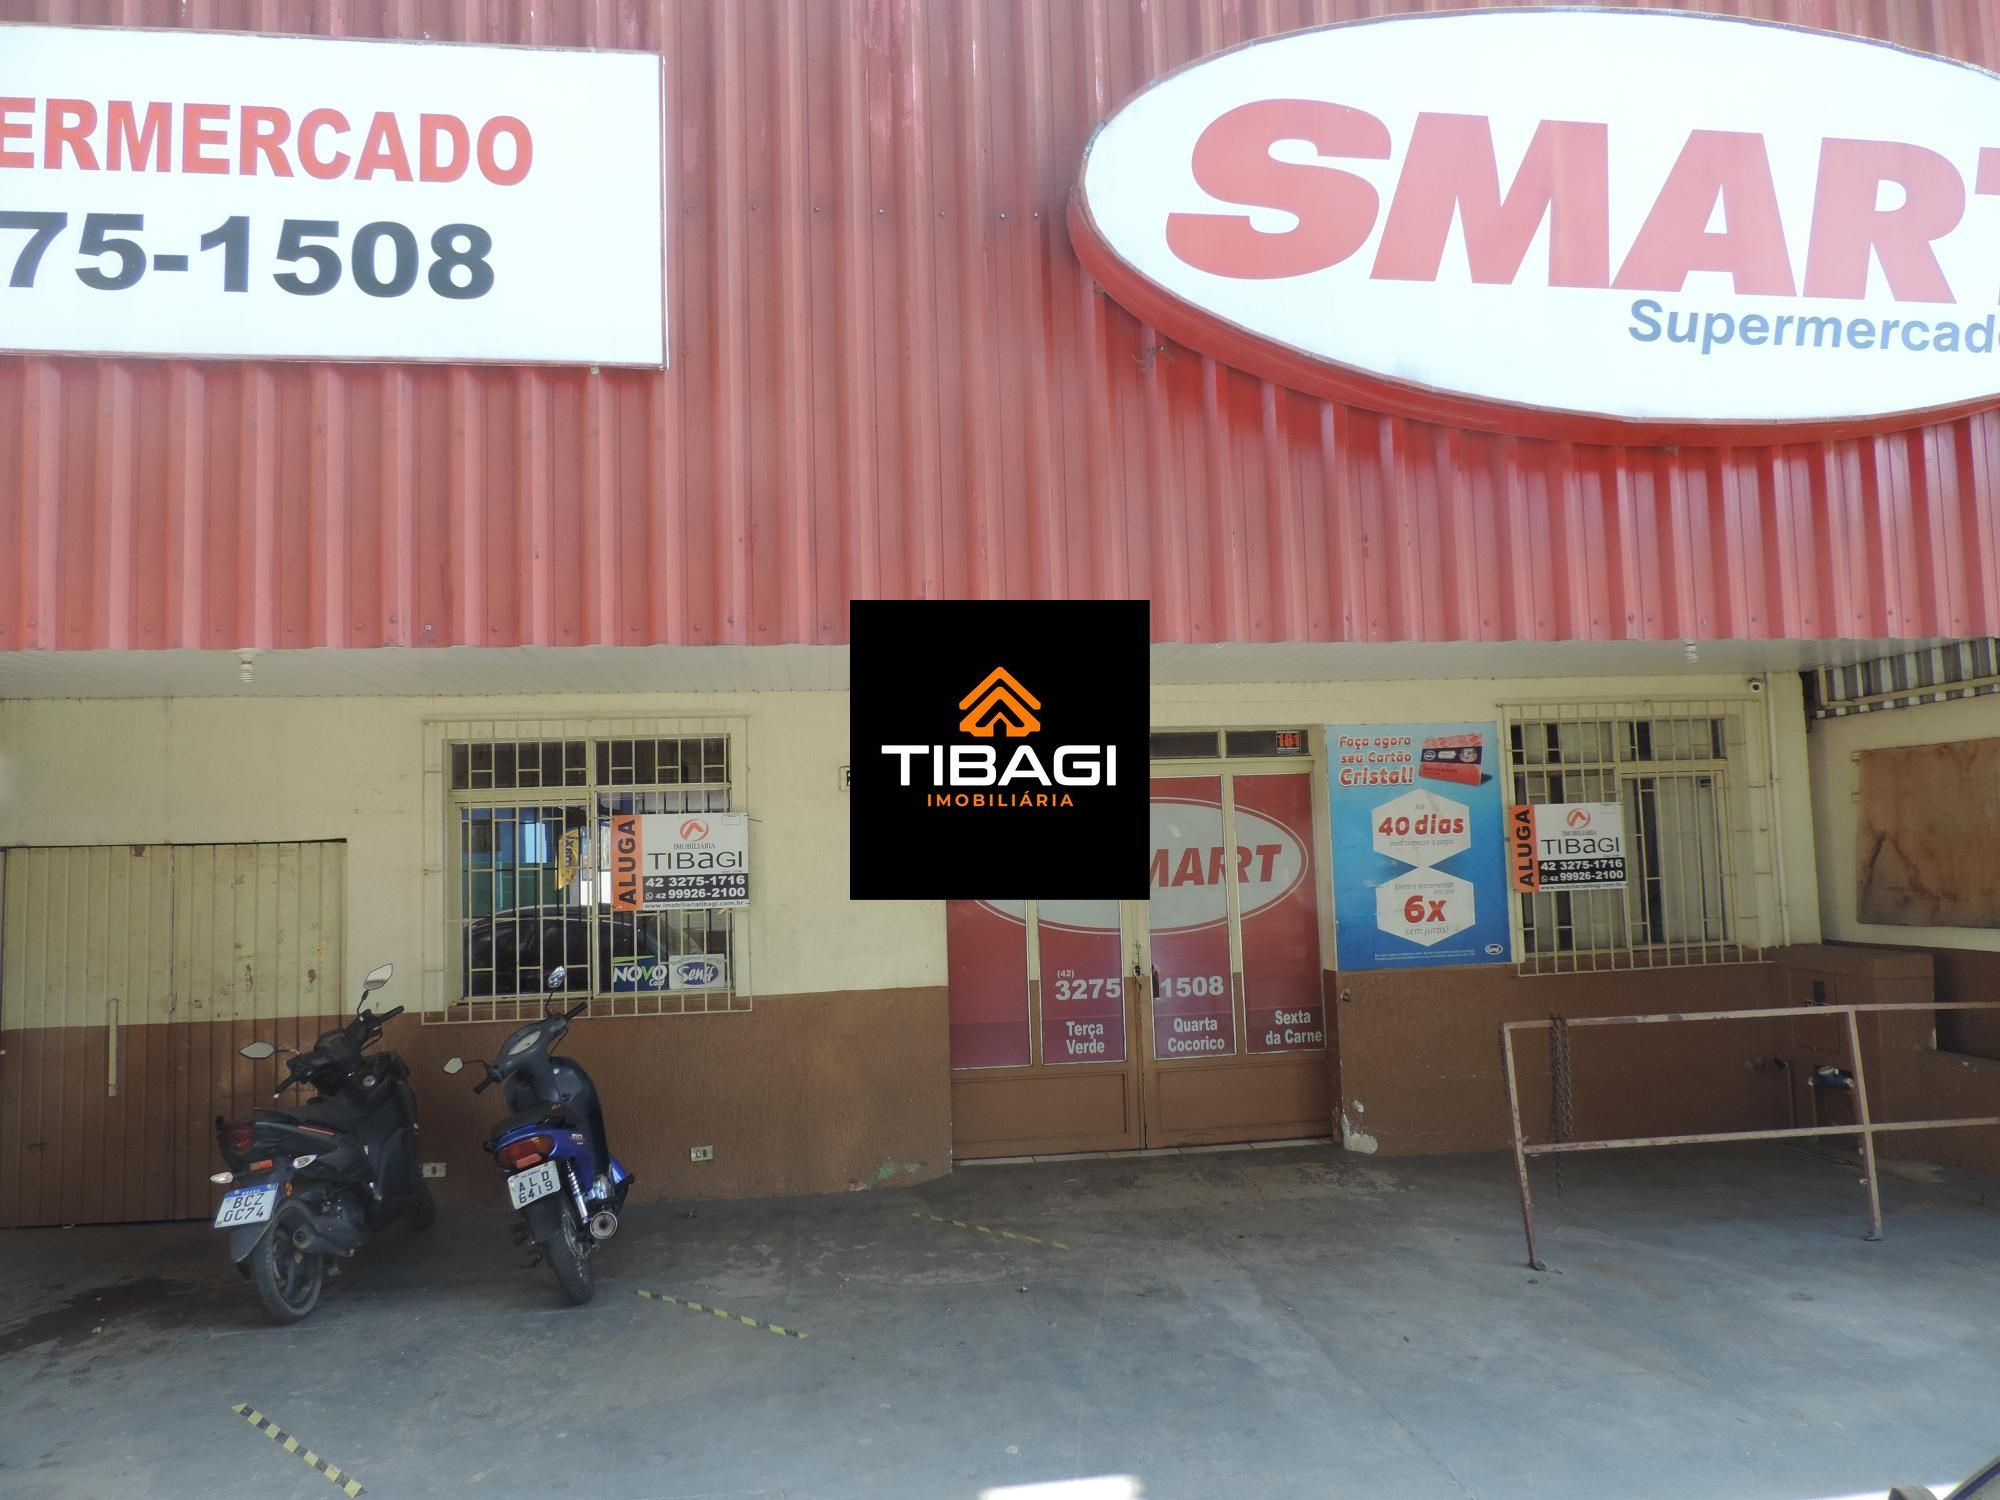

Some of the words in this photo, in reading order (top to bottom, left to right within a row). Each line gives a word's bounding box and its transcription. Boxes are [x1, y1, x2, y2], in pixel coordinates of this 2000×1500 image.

[0, 97, 533, 186] ERMERCADO
[1165, 98, 2000, 305] SMAR
[0, 210, 495, 299] 75-1508
[1628, 299, 2000, 354] Supermercad
[1339, 735, 1370, 750] Faça
[1374, 736, 1412, 749] agora
[1341, 754, 1363, 764] seu
[1368, 750, 1412, 763] Cartão
[1340, 766, 1414, 785] Cristal!
[1378, 816, 1410, 836] 40
[1414, 813, 1464, 835] dias
[1515, 809, 1535, 888] ALUGA
[618, 819, 636, 905] ALUGA
[1541, 862, 1556, 871] 42
[1560, 859, 1623, 871] 3275-1716
[645, 877, 664, 888] 42
[668, 875, 745, 887] 3275-1716
[1560, 870, 1624, 881] 99926-2100
[668, 887, 745, 898] 99926-2100
[1404, 895, 1447, 923] 6x
[613, 965, 667, 983] NOVO
[1057, 969, 1075, 978] (42)
[1056, 978, 1121, 1001] 3275
[1159, 976, 1224, 998] 1508
[1173, 1017, 1218, 1033] Quarta
[1275, 1010, 1311, 1025] Sexta
[1066, 1021, 1104, 1039] Terça
[1265, 1030, 1281, 1045] da
[1285, 1029, 1322, 1044] Carne
[1066, 1039, 1105, 1055] Verde
[1168, 1036, 1225, 1053] Cocorico
[519, 1180, 554, 1203] 6419
[233, 1193, 264, 1209] BCZ
